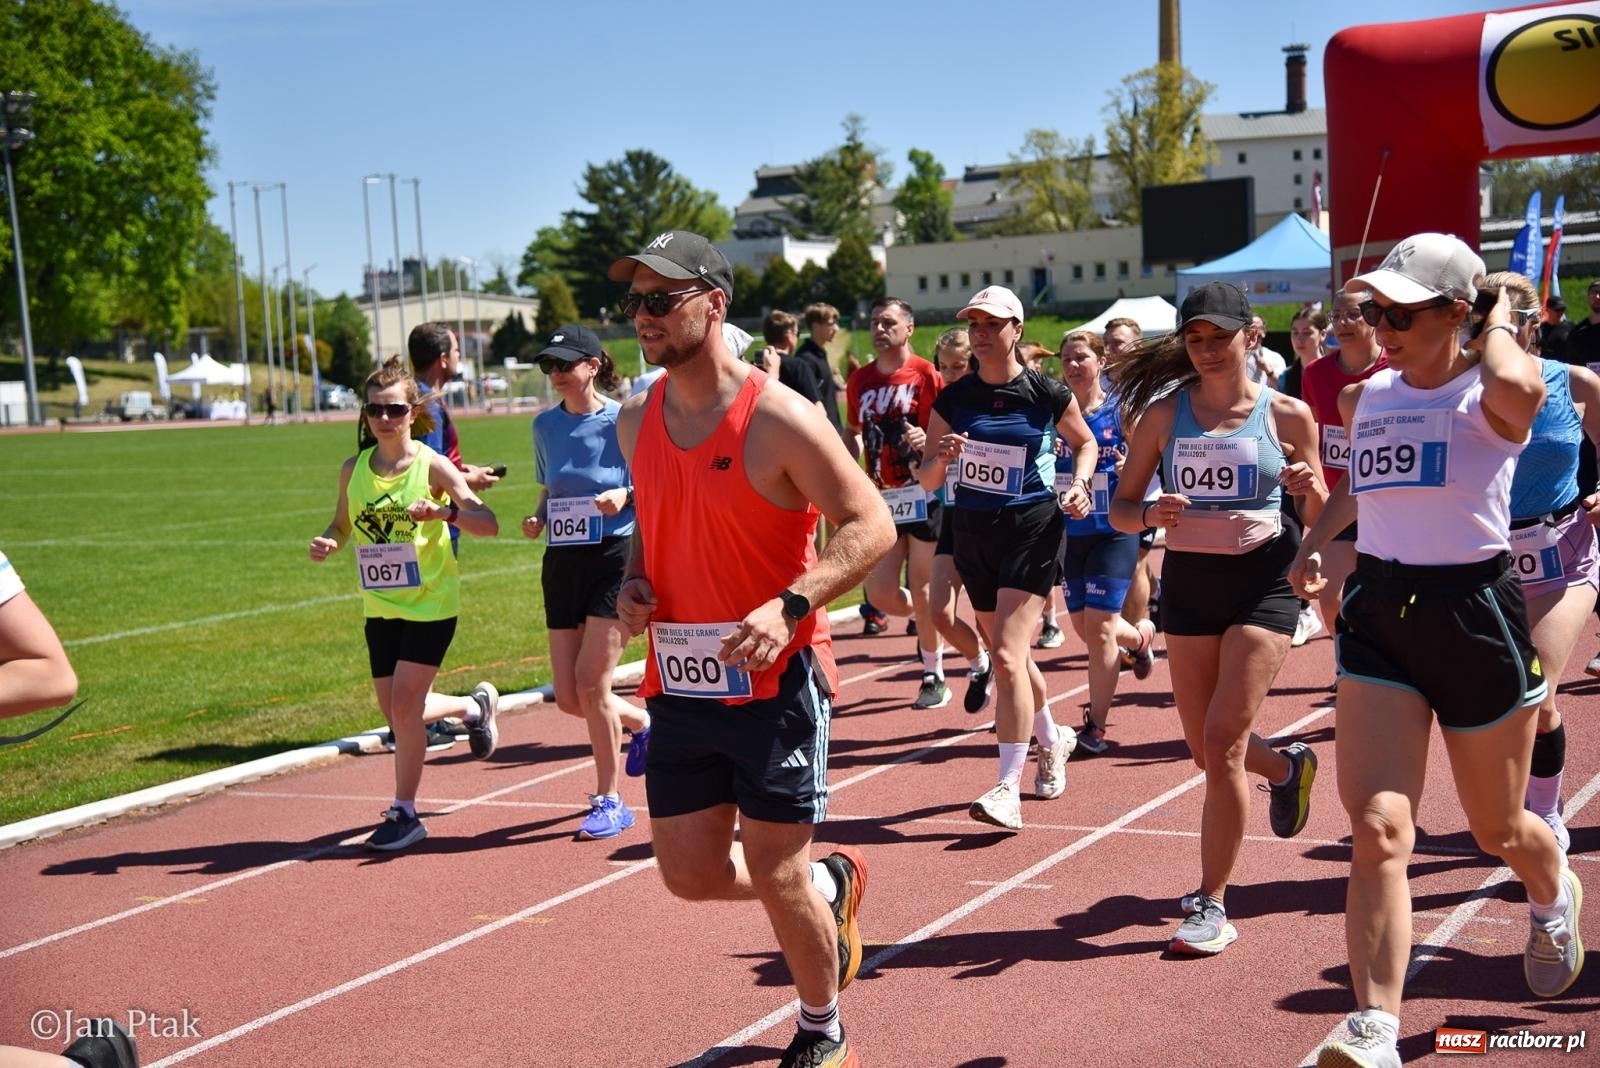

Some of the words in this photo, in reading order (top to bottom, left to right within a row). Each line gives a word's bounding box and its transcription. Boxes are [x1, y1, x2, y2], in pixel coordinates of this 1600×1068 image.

[858, 380, 920, 422] RUN
[1396, 415, 1425, 424] GRANIC
[965, 461, 1005, 485] 050
[1359, 444, 1416, 478] 059
[1181, 466, 1234, 490] 049
[553, 518, 587, 536] 064
[367, 564, 402, 581] 067
[669, 628, 683, 636] BIEG
[683, 629, 695, 637] BEZ
[696, 629, 720, 637] GRANIC
[666, 655, 722, 684] 060
